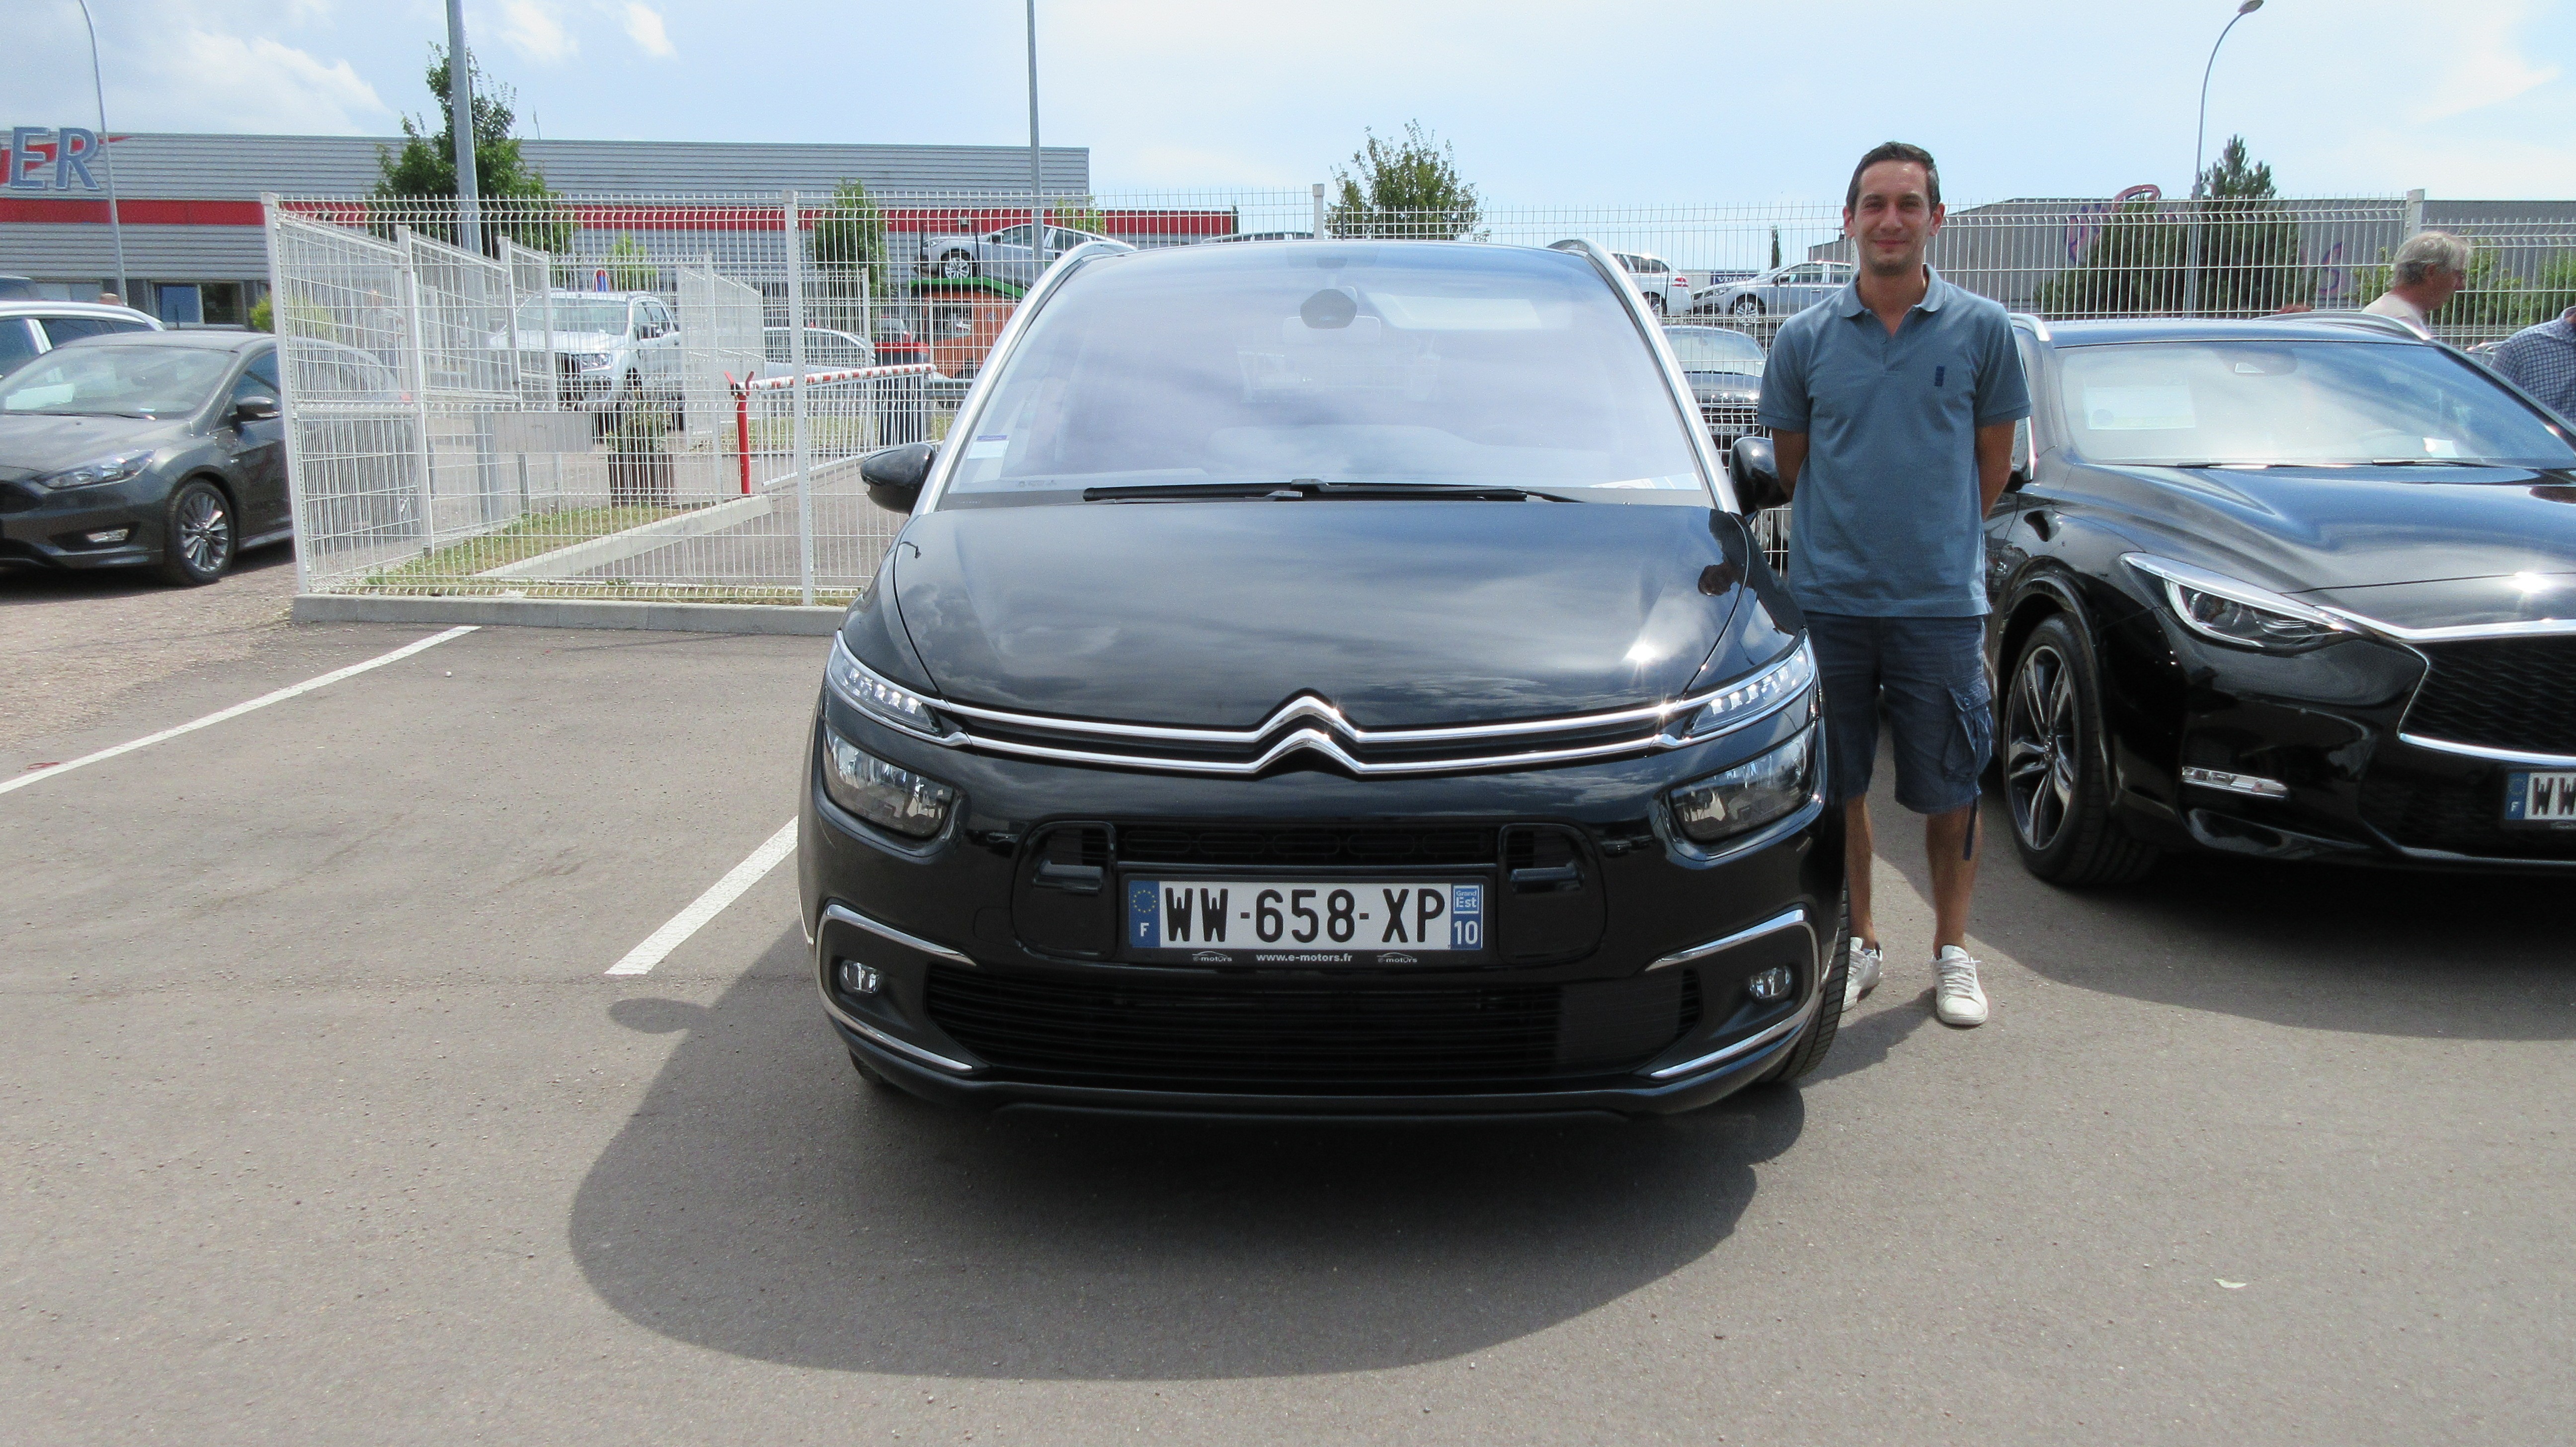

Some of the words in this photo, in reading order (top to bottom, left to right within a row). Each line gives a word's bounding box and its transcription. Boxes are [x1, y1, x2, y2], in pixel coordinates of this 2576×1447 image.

[2511, 801, 2519, 812] F
[1456, 896, 1477, 908] Est
[1165, 887, 1445, 943] WW-658-XP
[1140, 922, 1149, 937] F
[1454, 920, 1478, 945] 10
[1256, 953, 1353, 962] www.e-motors.fr
